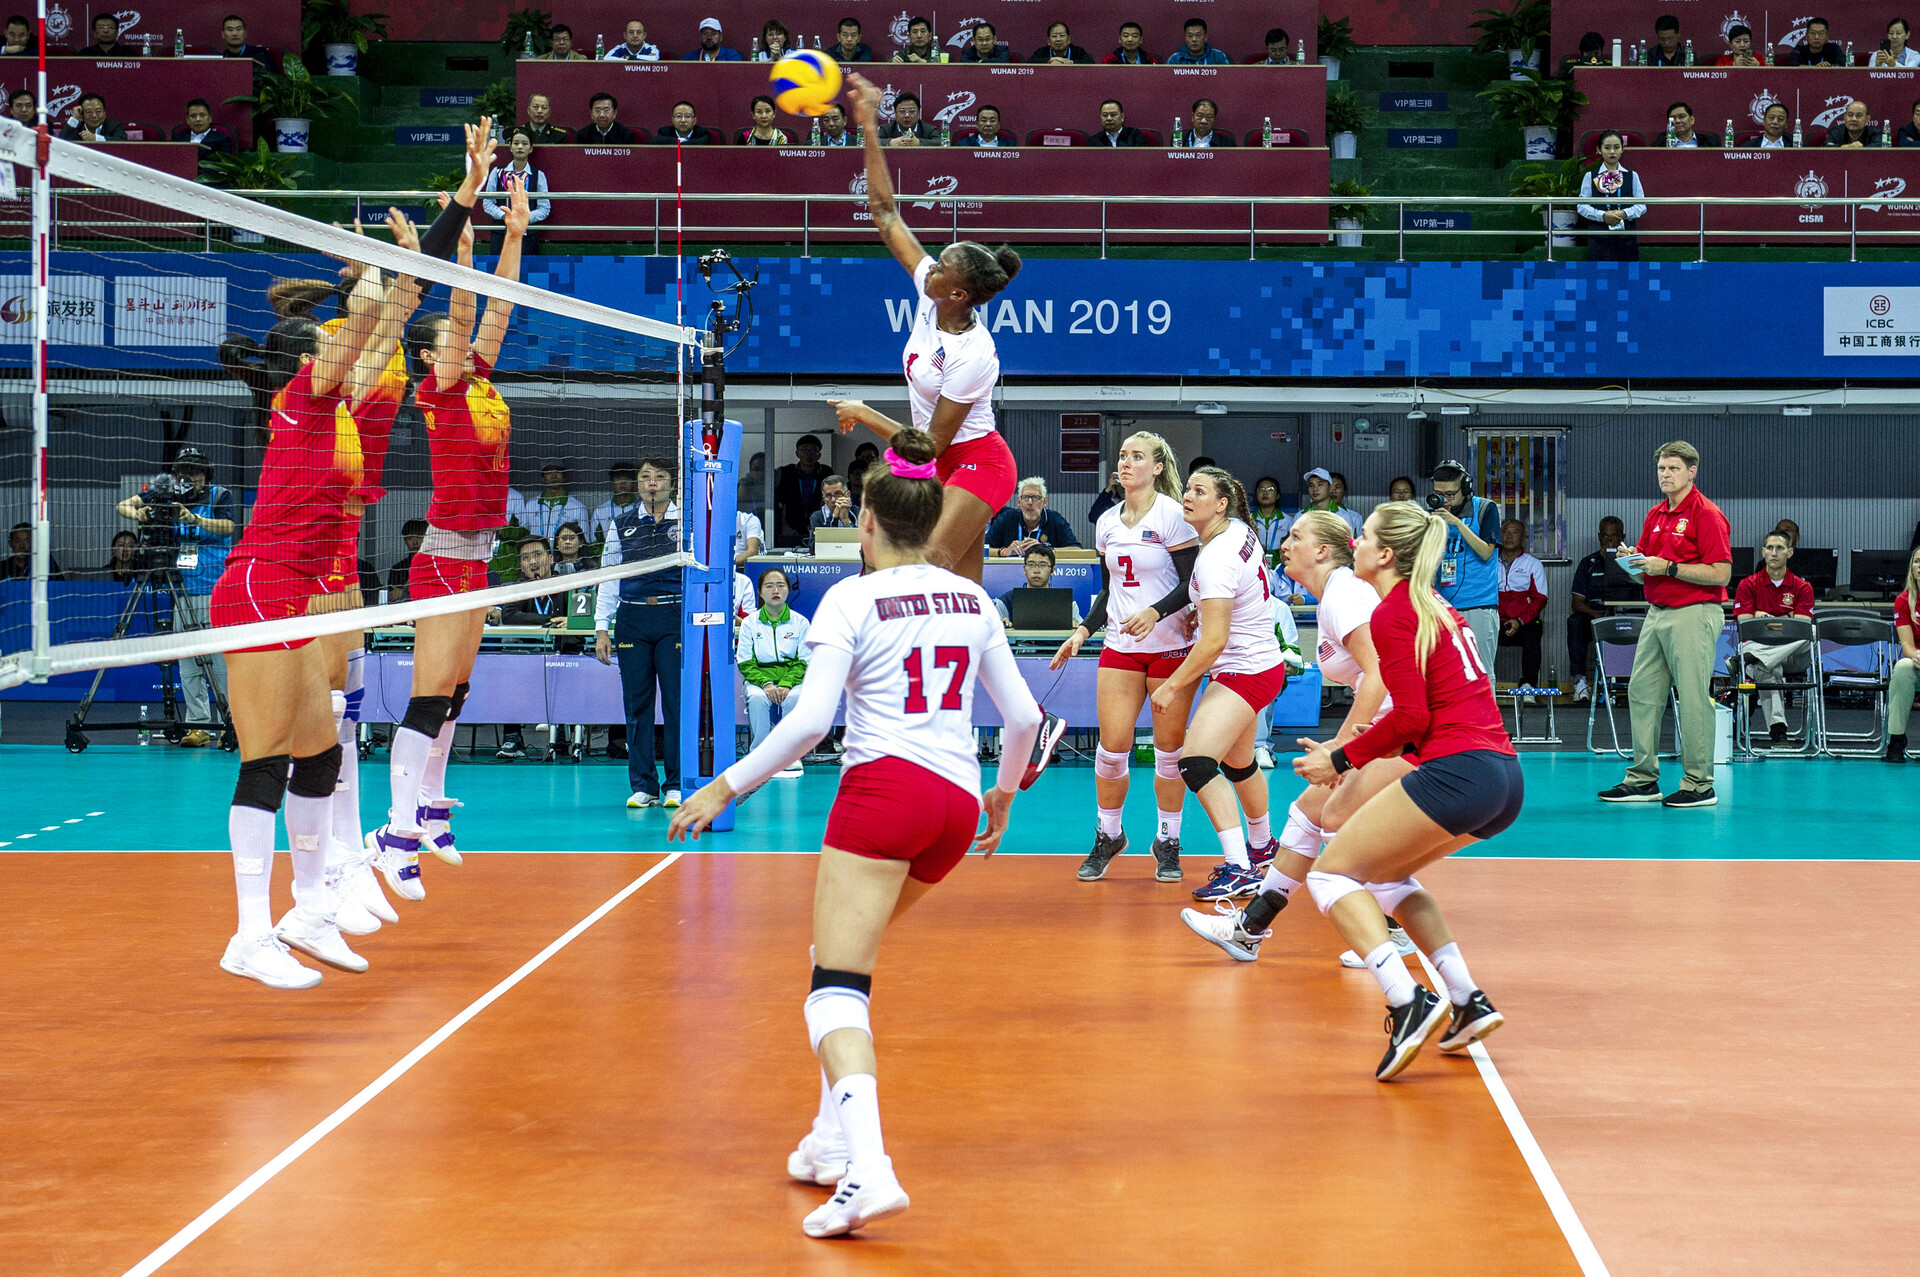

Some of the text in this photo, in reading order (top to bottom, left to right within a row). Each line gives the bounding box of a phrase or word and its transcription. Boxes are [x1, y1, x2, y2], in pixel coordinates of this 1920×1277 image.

[1395, 99, 1433, 108] VIP第三排
[411, 133, 450, 142] VIP第二排
[1403, 135, 1442, 144] VIP第二排
[585, 148, 631, 156] WUHAN 2019
[808, 150, 826, 158] 2019
[974, 151, 1020, 159] WUHAN 2019
[1197, 152, 1214, 160] 2019
[1724, 152, 1771, 160] WUHAN 2019
[1413, 218, 1455, 228] VIP第一排
[1799, 214, 1824, 223] CISM
[884, 298, 1172, 336] WAN 2019
[1866, 318, 1895, 329] ICBC
[1839, 334, 1920, 348] 中国工商银行
[704, 461, 722, 469] FIVB
[783, 565, 841, 575] WUHAN 2019
[1065, 567, 1087, 577] 2019
[1117, 555, 1135, 581] 7
[576, 595, 588, 614] 2
[875, 592, 982, 622] UNITED STATES
[903, 645, 970, 715] 17
